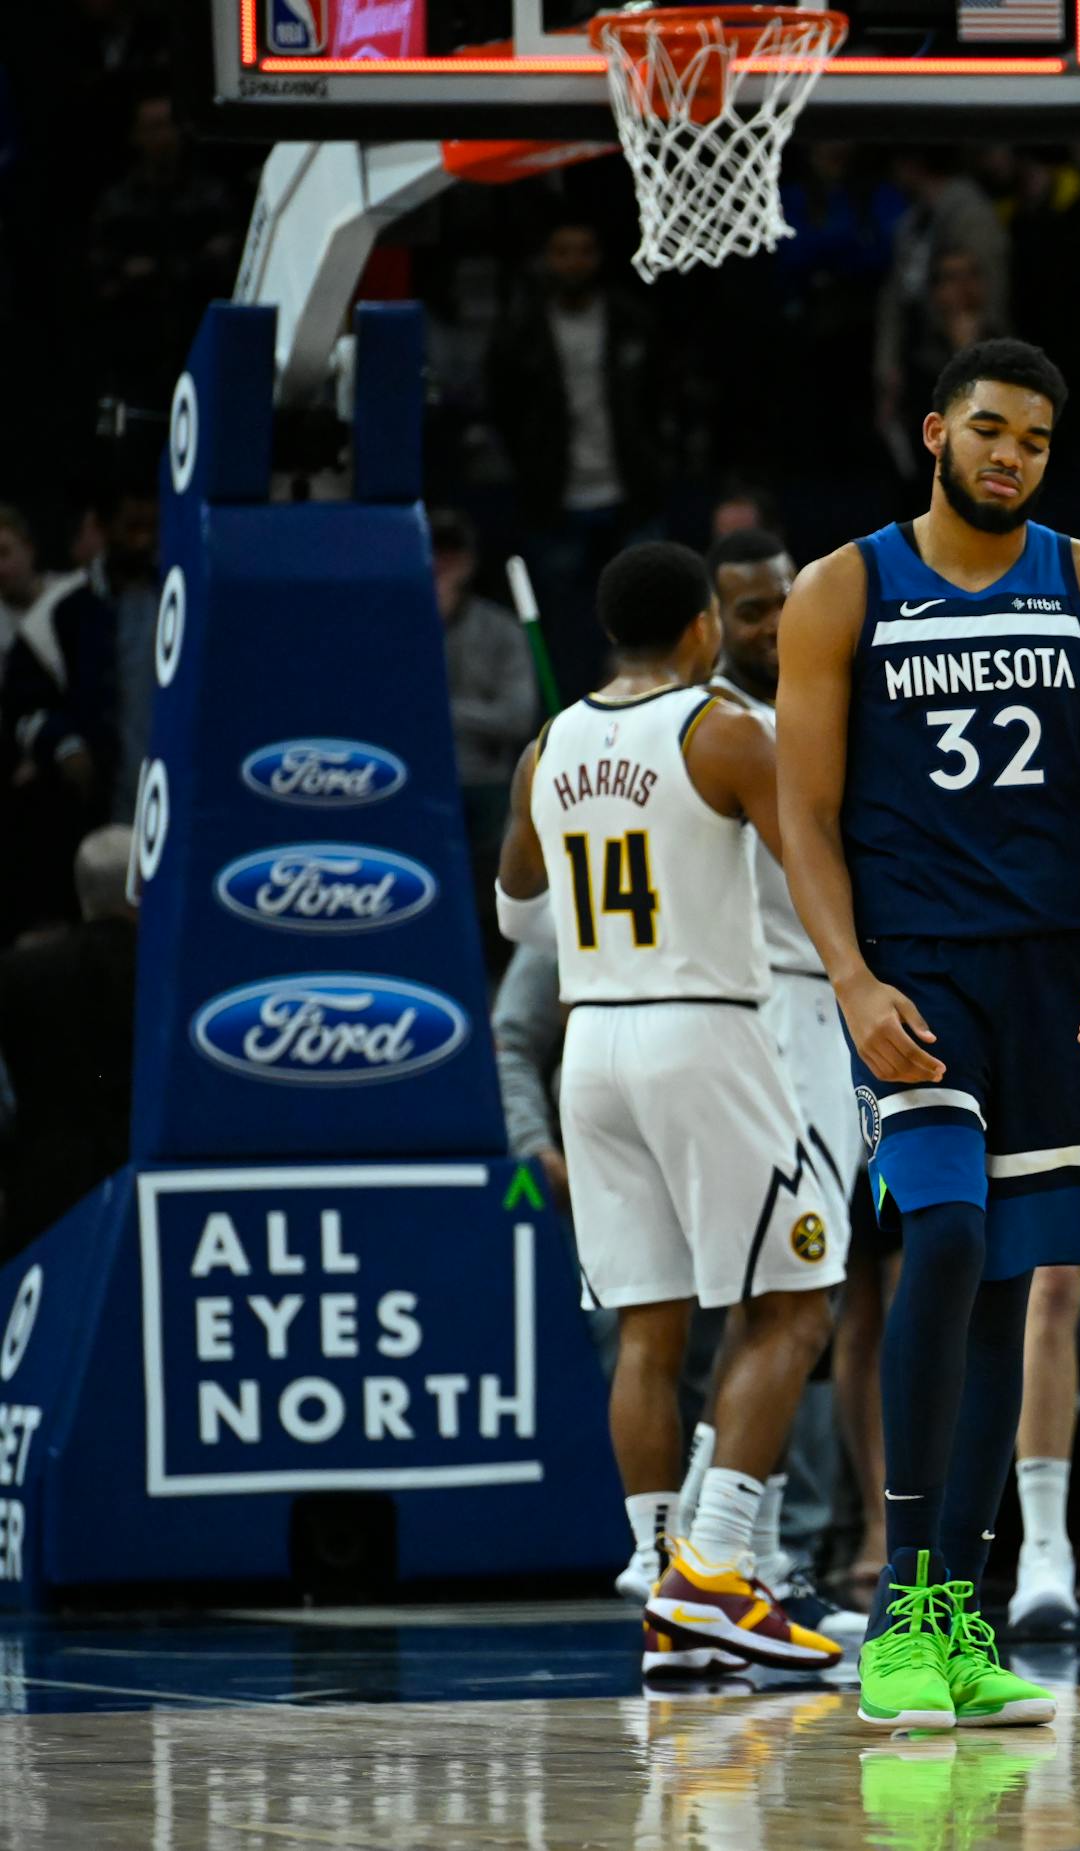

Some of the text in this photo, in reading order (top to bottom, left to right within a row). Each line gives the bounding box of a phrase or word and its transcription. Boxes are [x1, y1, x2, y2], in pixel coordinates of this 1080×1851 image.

[1027, 598, 1062, 611] fitbit
[884, 648, 1076, 700] MINNESOTA
[271, 748, 378, 797] Ford
[926, 705, 1044, 790] 32
[553, 759, 658, 811] HARRIS
[256, 855, 397, 917] Ford
[562, 829, 660, 950] 14
[243, 992, 418, 1066] Ford
[191, 1210, 359, 1277] ALL
[195, 1290, 422, 1361] EYES
[199, 1374, 536, 1444] NORTH
